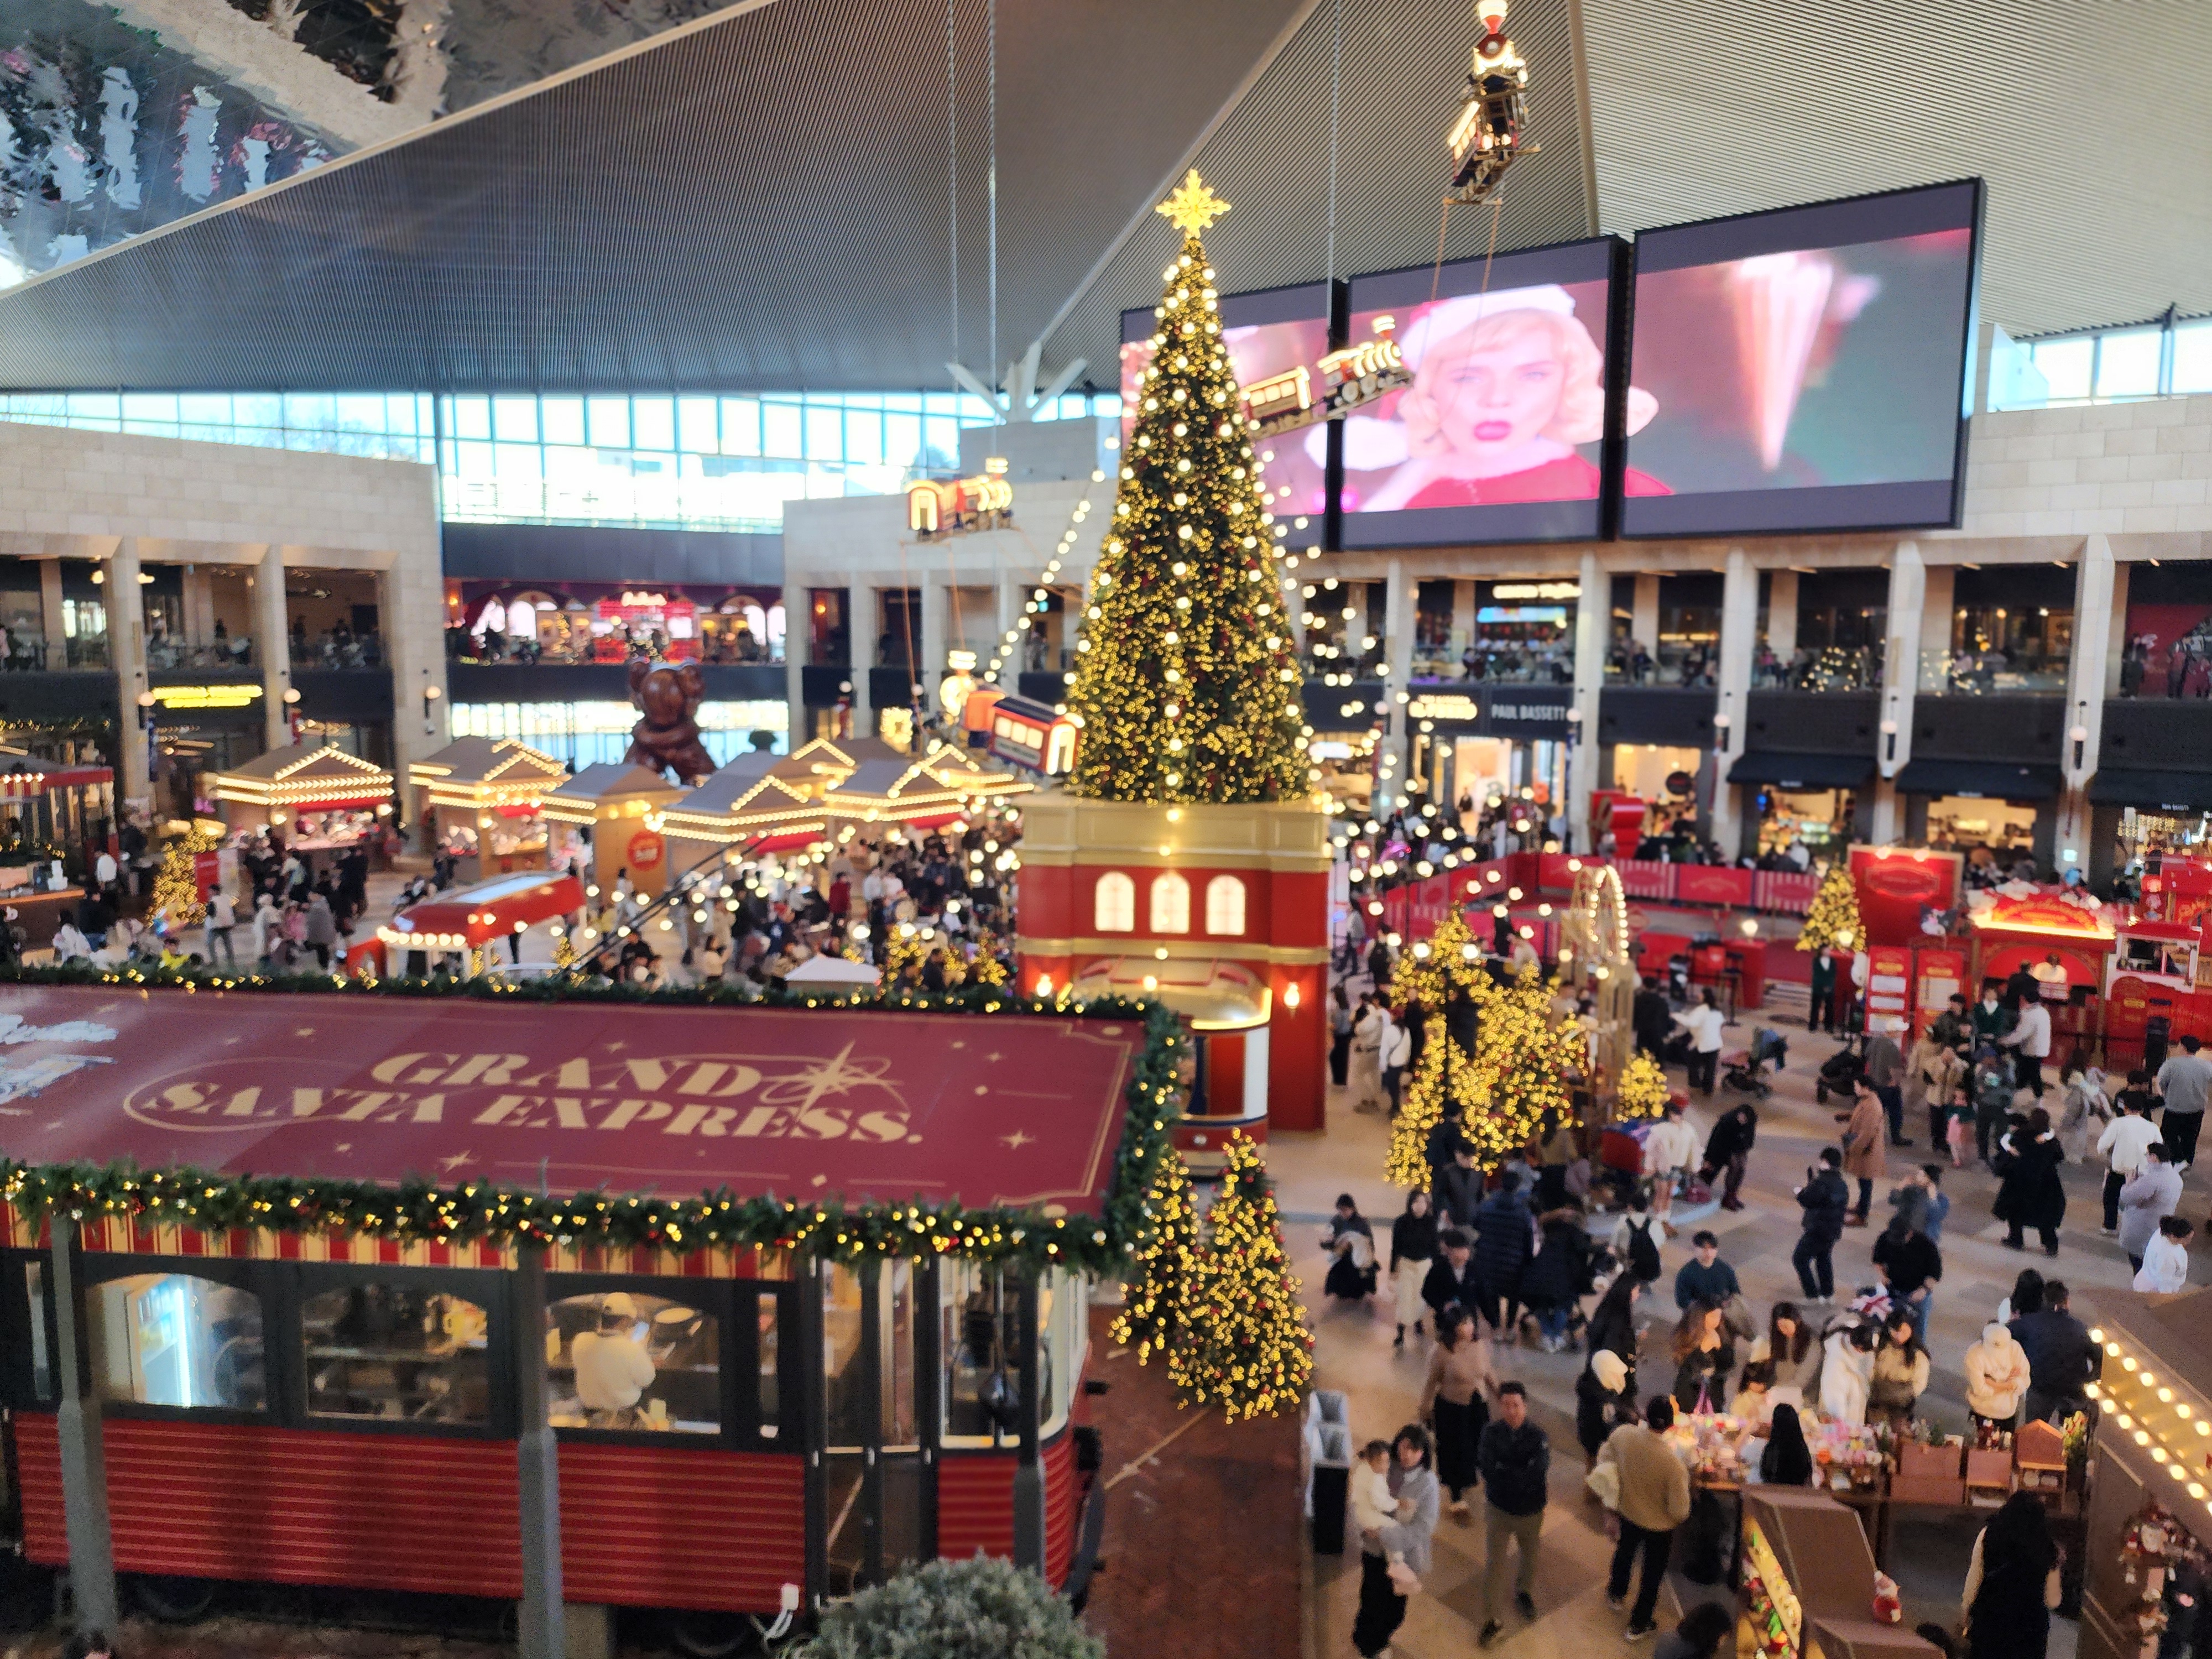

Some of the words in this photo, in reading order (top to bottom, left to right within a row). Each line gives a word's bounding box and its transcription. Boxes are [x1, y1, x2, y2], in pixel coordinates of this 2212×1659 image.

[1491, 703, 1518, 720] PAUL
[1519, 704, 1566, 721] BASSETT
[371, 1052, 763, 1097] GRAND
[142, 1082, 446, 1124] SANTA
[472, 1094, 924, 1145] EXPRESS.
